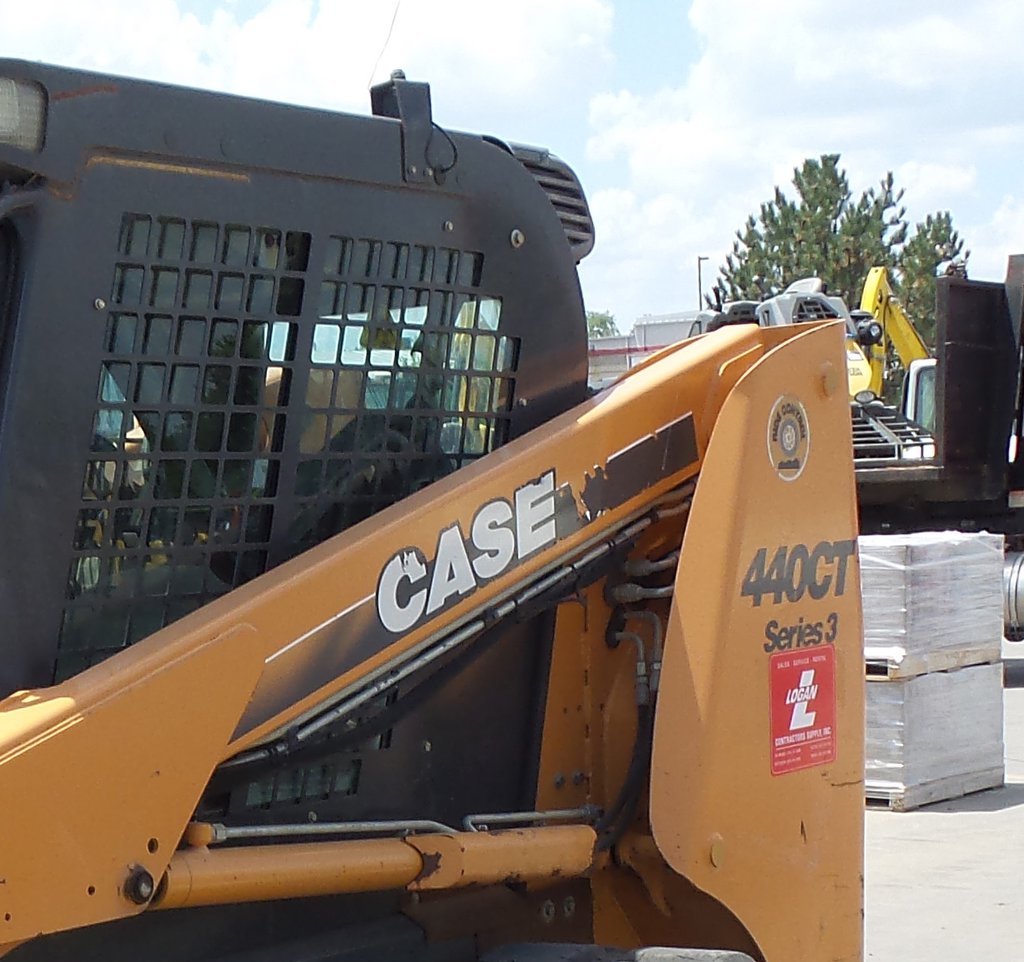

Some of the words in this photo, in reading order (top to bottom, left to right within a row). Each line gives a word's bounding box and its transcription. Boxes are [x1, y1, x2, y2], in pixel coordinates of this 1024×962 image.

[377, 469, 557, 634] CASE
[741, 540, 856, 607] 440CT
[764, 617, 823, 652] Series
[825, 612, 838, 642] 3
[786, 684, 818, 704] LOGAN
